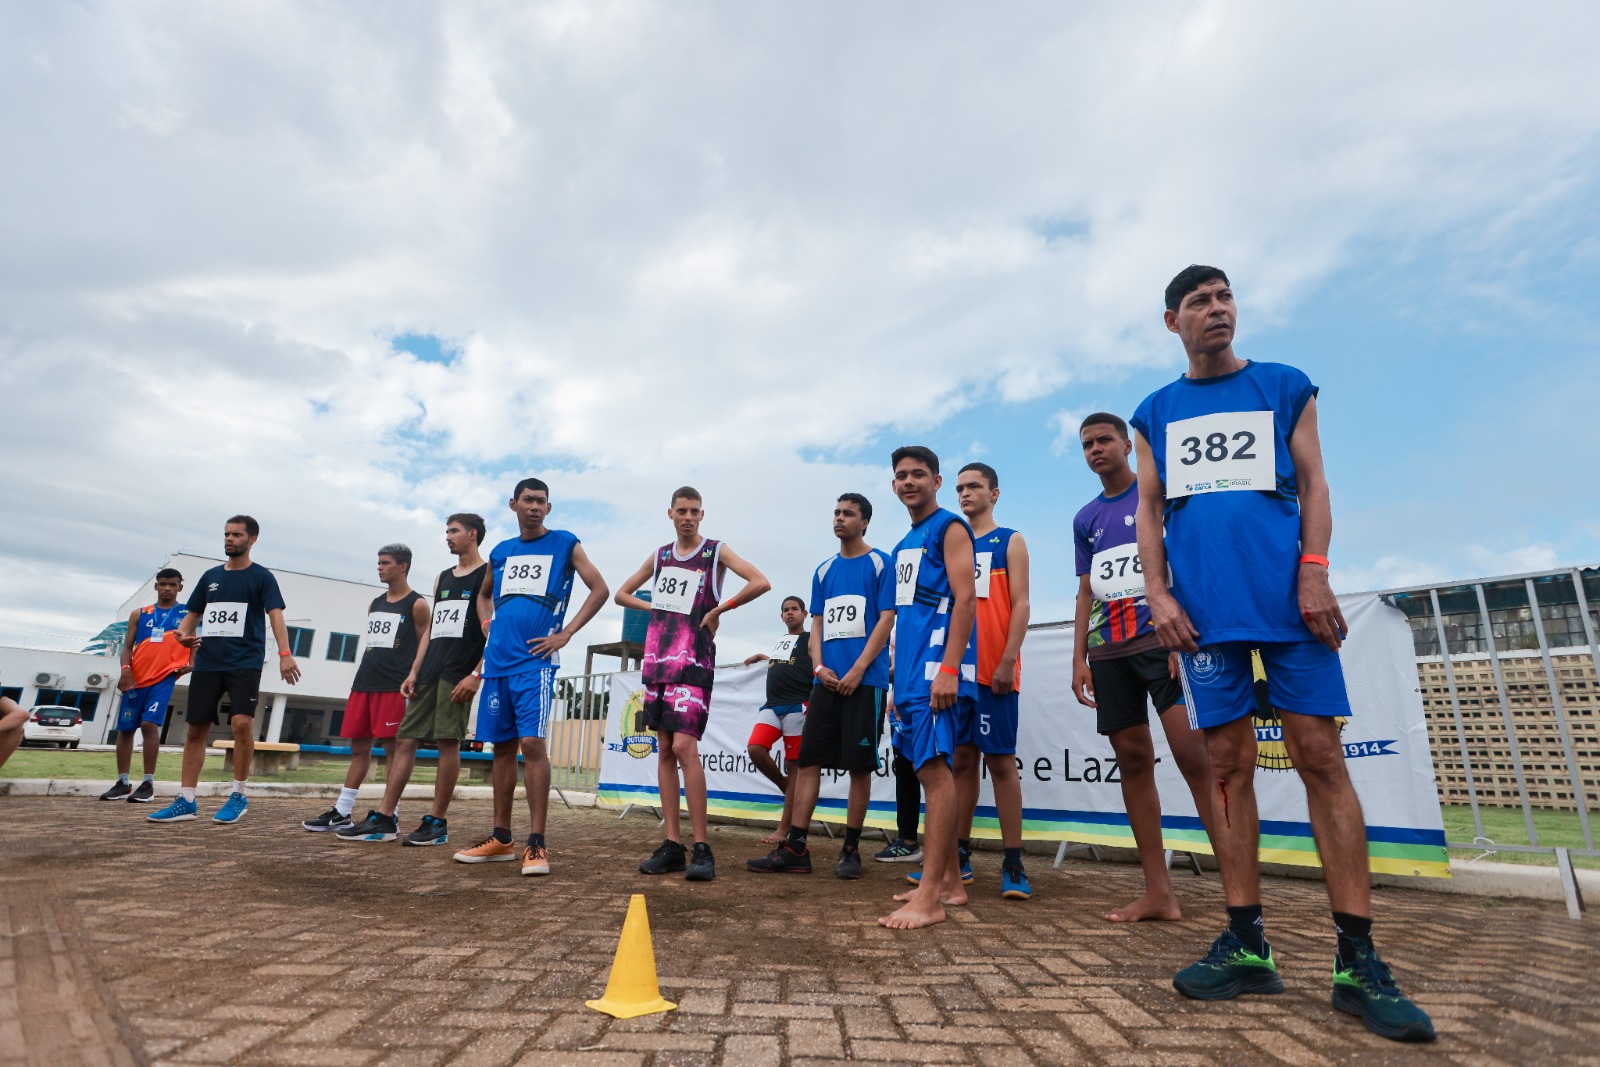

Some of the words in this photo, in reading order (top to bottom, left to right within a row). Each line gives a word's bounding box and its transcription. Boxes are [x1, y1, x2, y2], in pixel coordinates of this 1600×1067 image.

[1180, 431, 1256, 466] 382
[508, 564, 542, 580] 383
[896, 562, 914, 585] 80
[1100, 555, 1143, 580] 378
[658, 576, 688, 597] 381
[208, 610, 239, 624] 384
[435, 608, 460, 625] 374
[827, 604, 857, 624] 379
[145, 618, 154, 628] 4
[367, 620, 392, 634] 388
[772, 640, 791, 652] 76
[148, 701, 159, 713] 4
[673, 686, 691, 712] 2
[979, 713, 991, 736] 5
[627, 736, 653, 744] OUTUBRO
[1342, 742, 1381, 757] 1914
[677, 749, 757, 774] retaria
[1034, 757, 1052, 781] e
